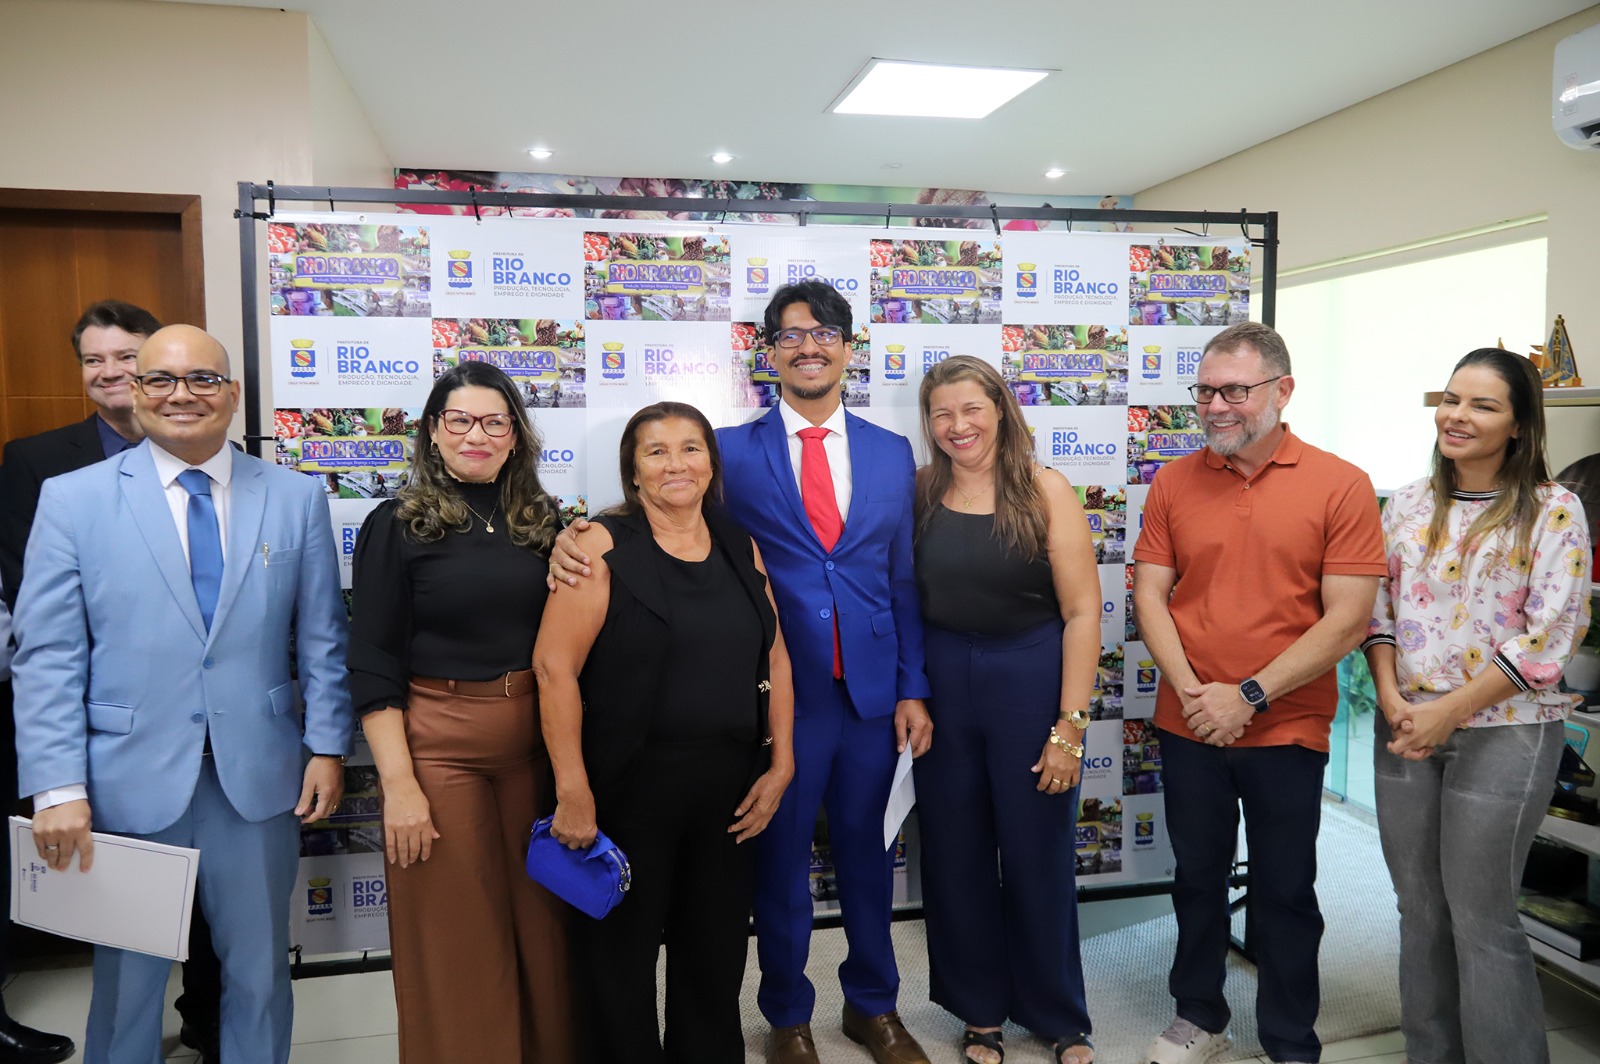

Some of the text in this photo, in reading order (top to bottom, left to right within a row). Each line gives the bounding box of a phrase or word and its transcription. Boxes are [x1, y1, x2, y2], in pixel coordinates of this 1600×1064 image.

[296, 256, 399, 276] RIO BRANCO
[493, 257, 524, 271] RIO
[788, 264, 815, 276] RIO
[493, 271, 571, 285] BRANCO
[609, 263, 702, 282] RIO BRANCO
[893, 269, 976, 287] RIO BRANCO
[1054, 269, 1079, 281] RIO
[1054, 282, 1118, 294] BRANCO
[1150, 274, 1227, 290] RIO BRANCO
[337, 346, 369, 359] RIO
[489, 350, 556, 368] BRANCO
[645, 349, 674, 361] RIO
[923, 350, 949, 362] RIO
[1177, 351, 1202, 362] RIO
[337, 360, 419, 373] BRANCO
[645, 362, 719, 375] BRANCO
[1024, 354, 1104, 370] RIO BRANCO
[1052, 431, 1078, 443] RIO
[1148, 433, 1170, 449] RIO
[302, 440, 403, 458] RIO BRANCO
[1052, 443, 1116, 455] BRANCO
[342, 527, 359, 540] RI
[353, 880, 384, 894] RIO
